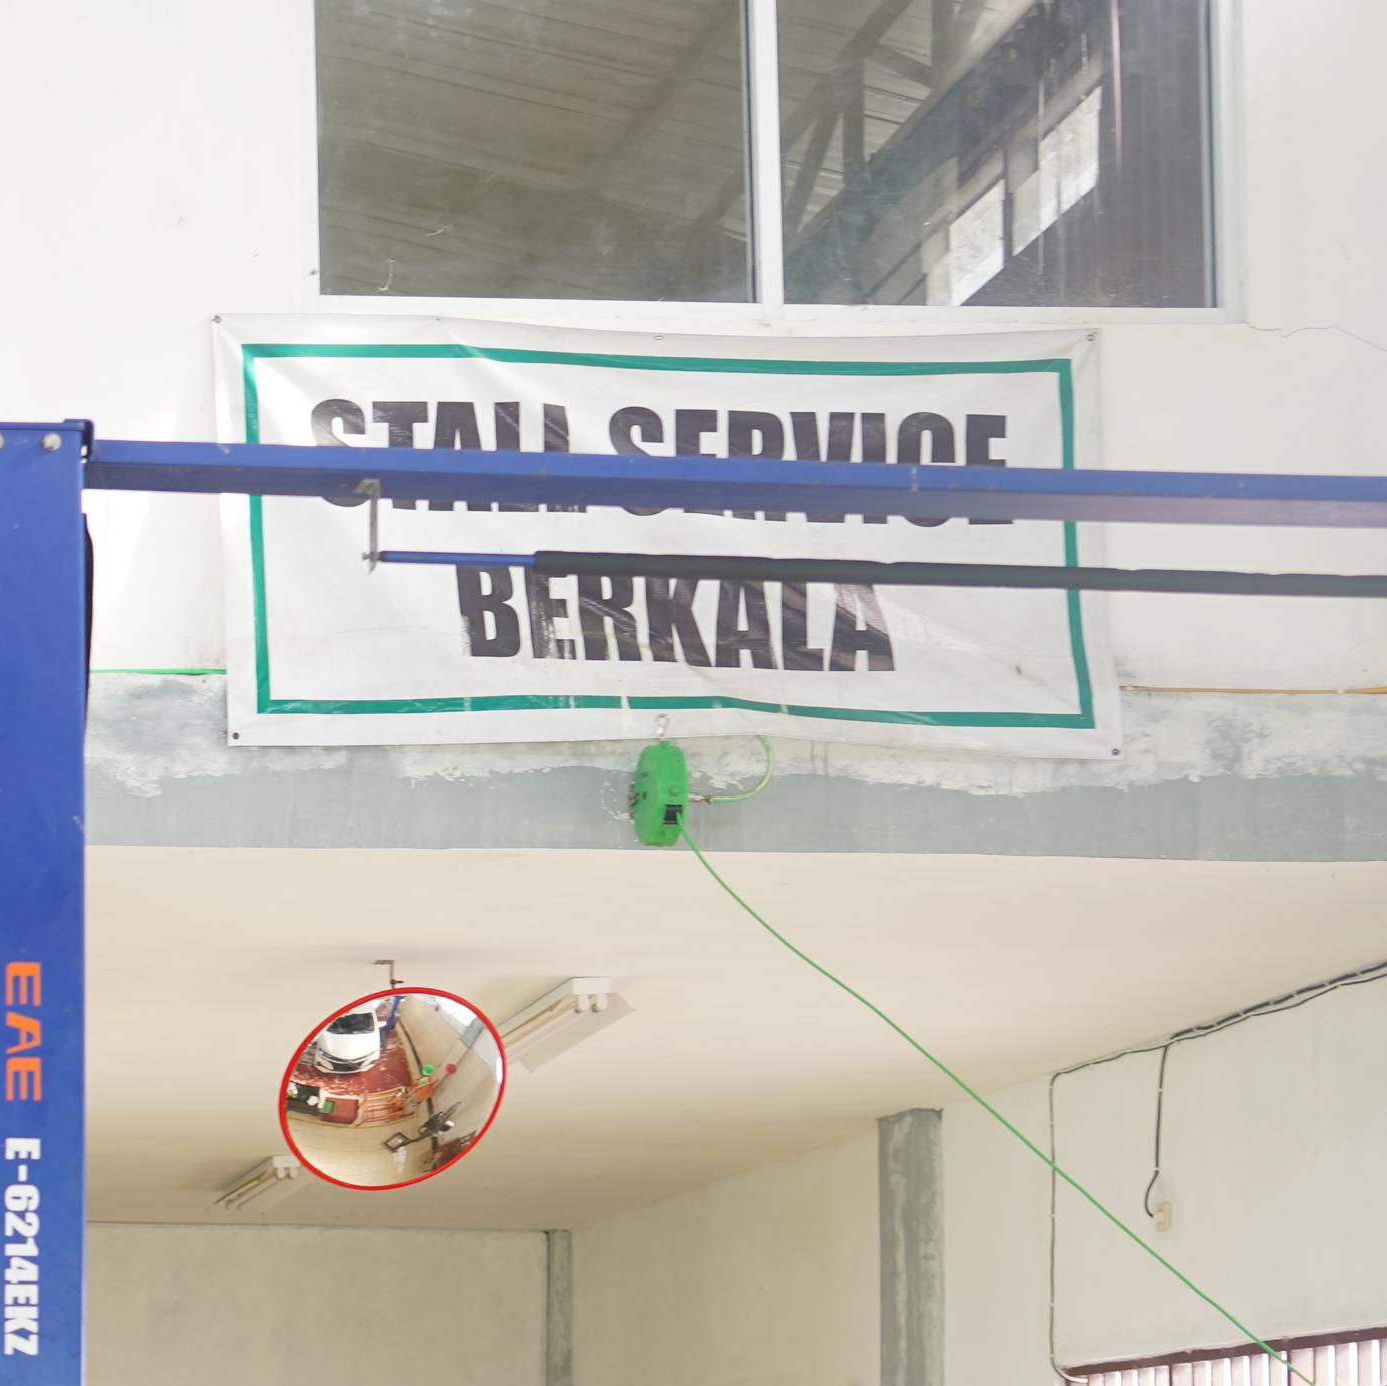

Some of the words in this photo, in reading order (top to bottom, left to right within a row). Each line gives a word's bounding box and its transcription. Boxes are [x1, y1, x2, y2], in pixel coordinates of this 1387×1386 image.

[310, 398, 588, 513] STALL
[609, 406, 1014, 528] SERVICE
[456, 558, 895, 672] BERKALA
[5, 962, 42, 1101] EAE
[4, 1138, 41, 1356] E-6214EKZ
